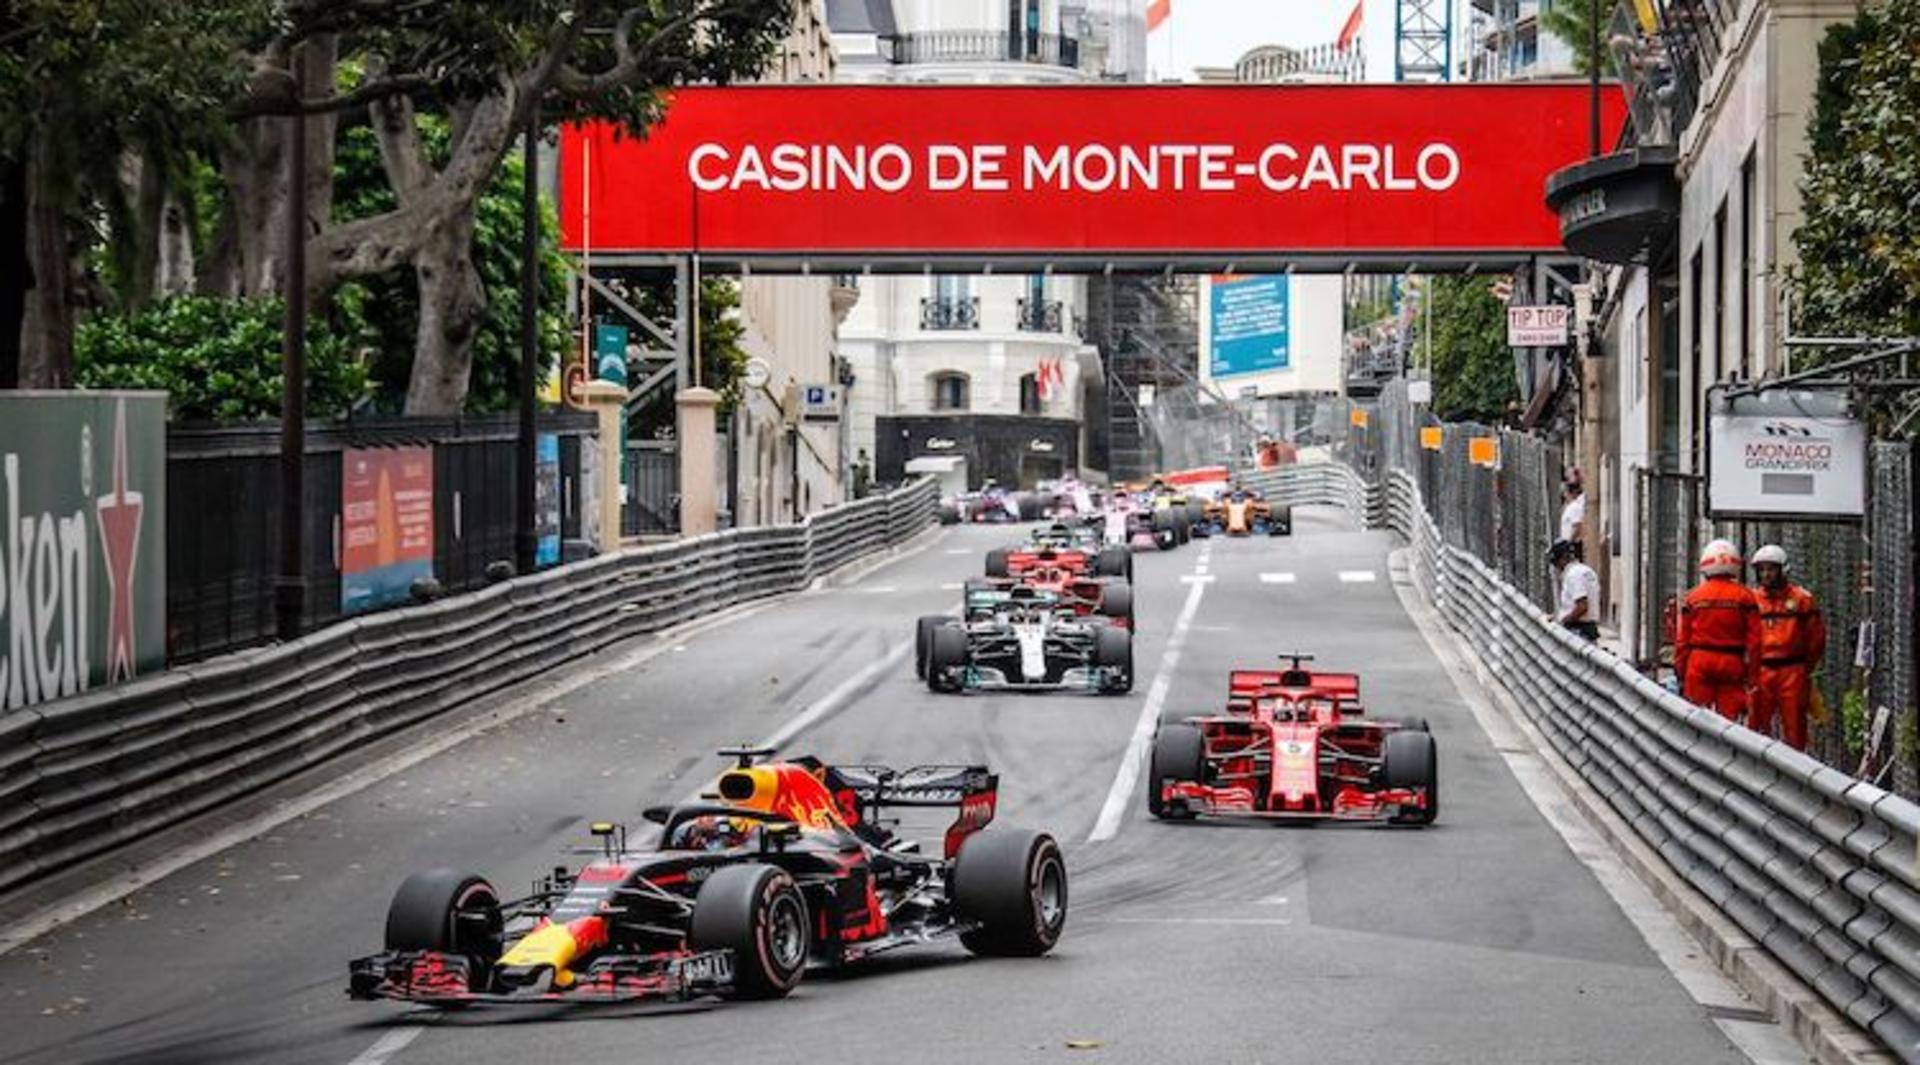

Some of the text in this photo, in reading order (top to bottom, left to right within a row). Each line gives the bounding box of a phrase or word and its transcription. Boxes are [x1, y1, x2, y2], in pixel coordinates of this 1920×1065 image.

[688, 143, 1460, 192] CASINO DE MONTE-CARLO
[1511, 309, 1565, 327] TIP TOP
[1745, 443, 1832, 459] MONACO
